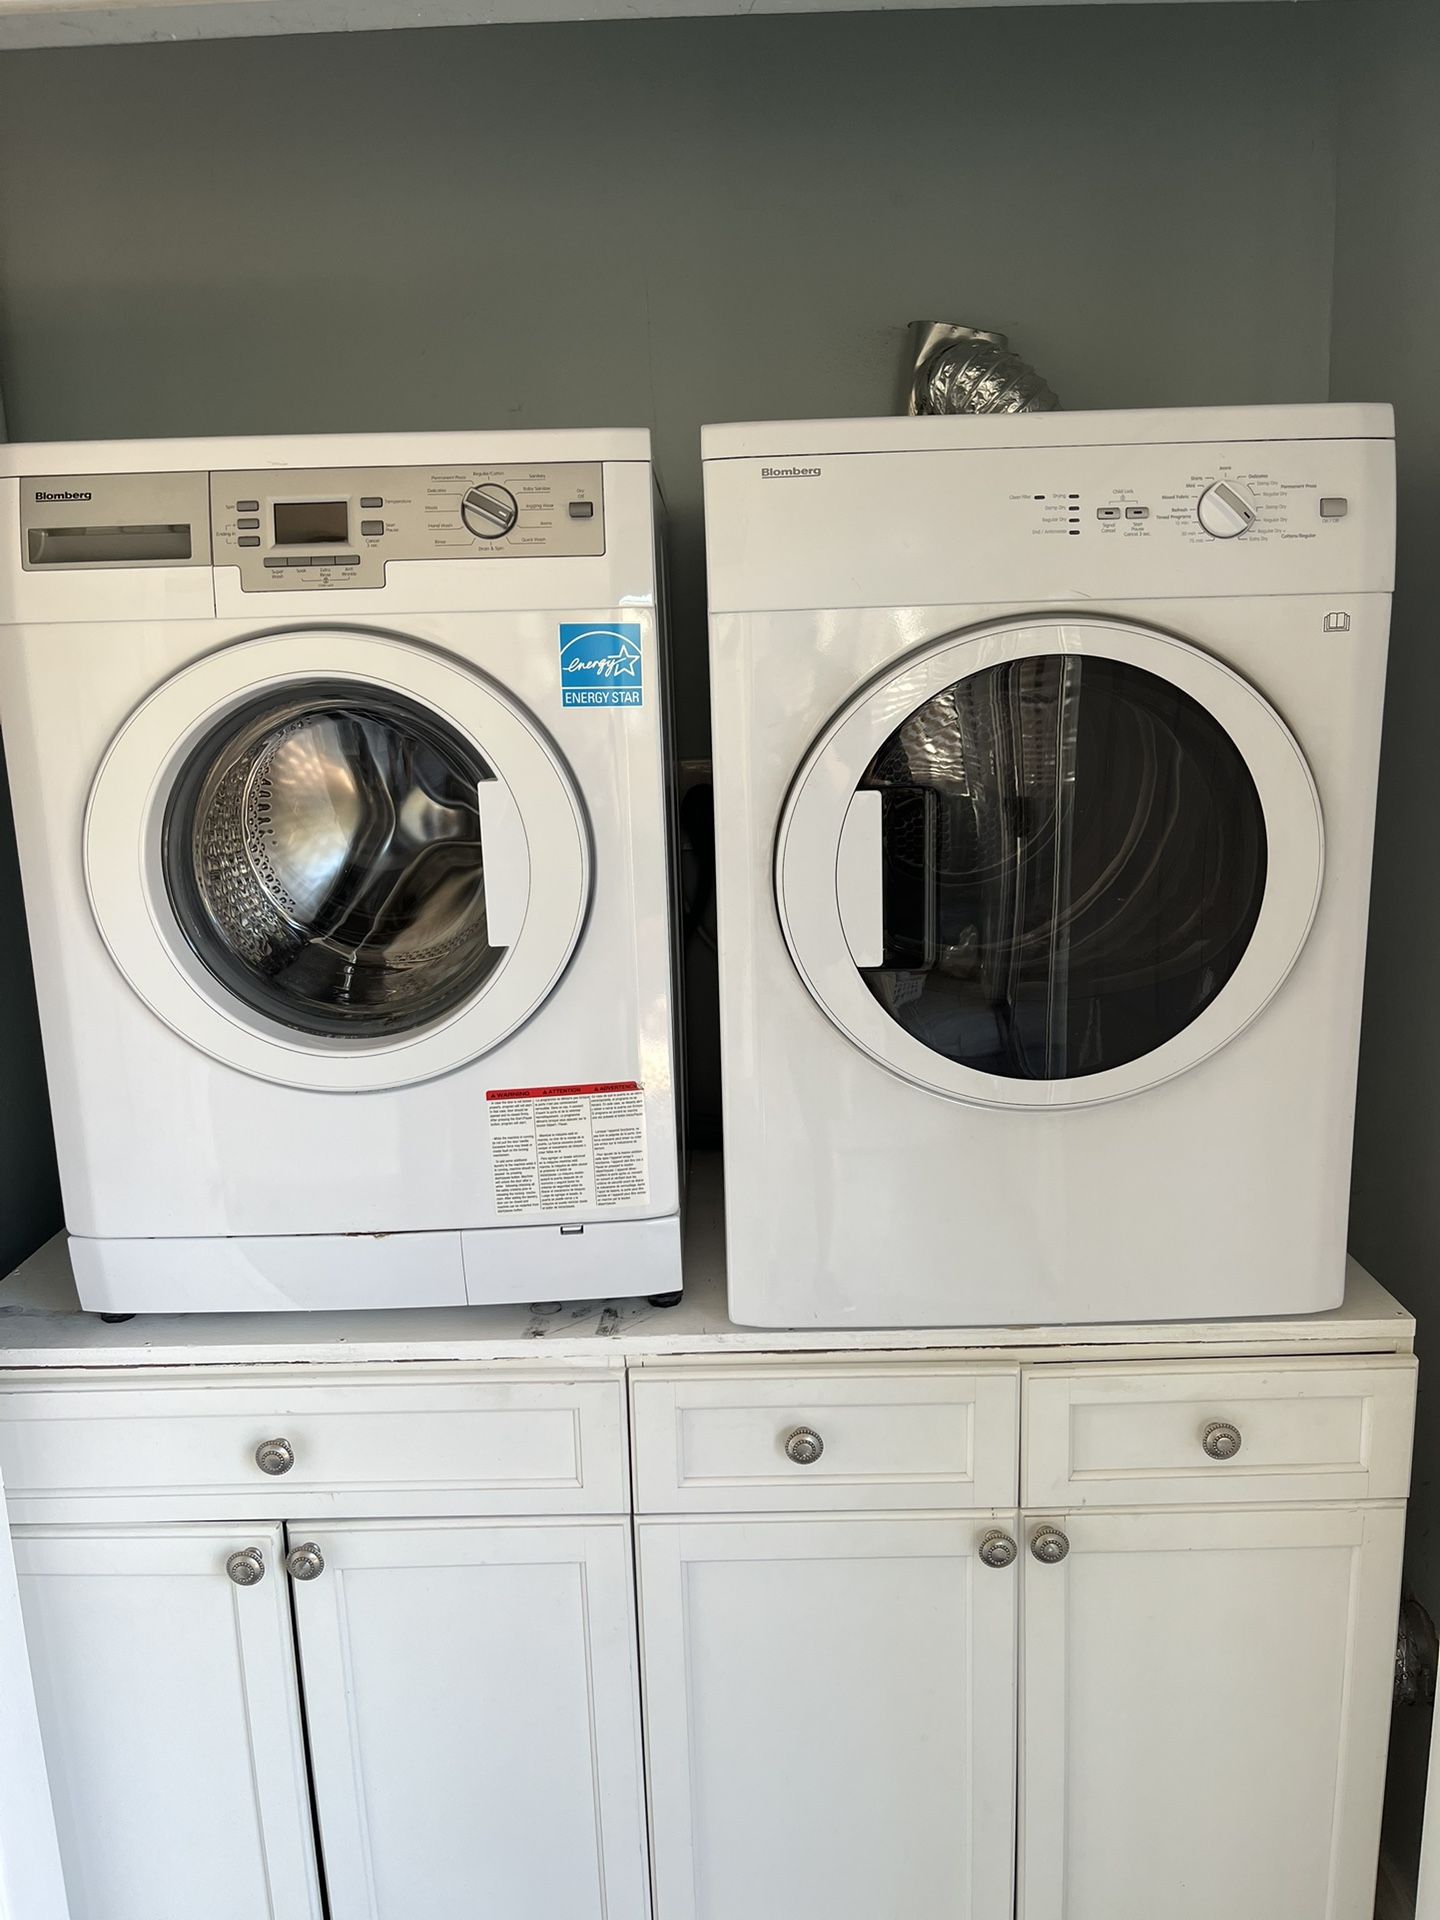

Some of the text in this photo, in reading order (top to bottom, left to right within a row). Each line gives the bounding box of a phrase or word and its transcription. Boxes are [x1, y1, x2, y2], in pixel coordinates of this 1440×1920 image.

[761, 467, 821, 479] Blomberg
[36, 491, 92, 502] Blomberg
[564, 657, 620, 677] energy
[565, 691, 640, 704] ENERGY STAR
